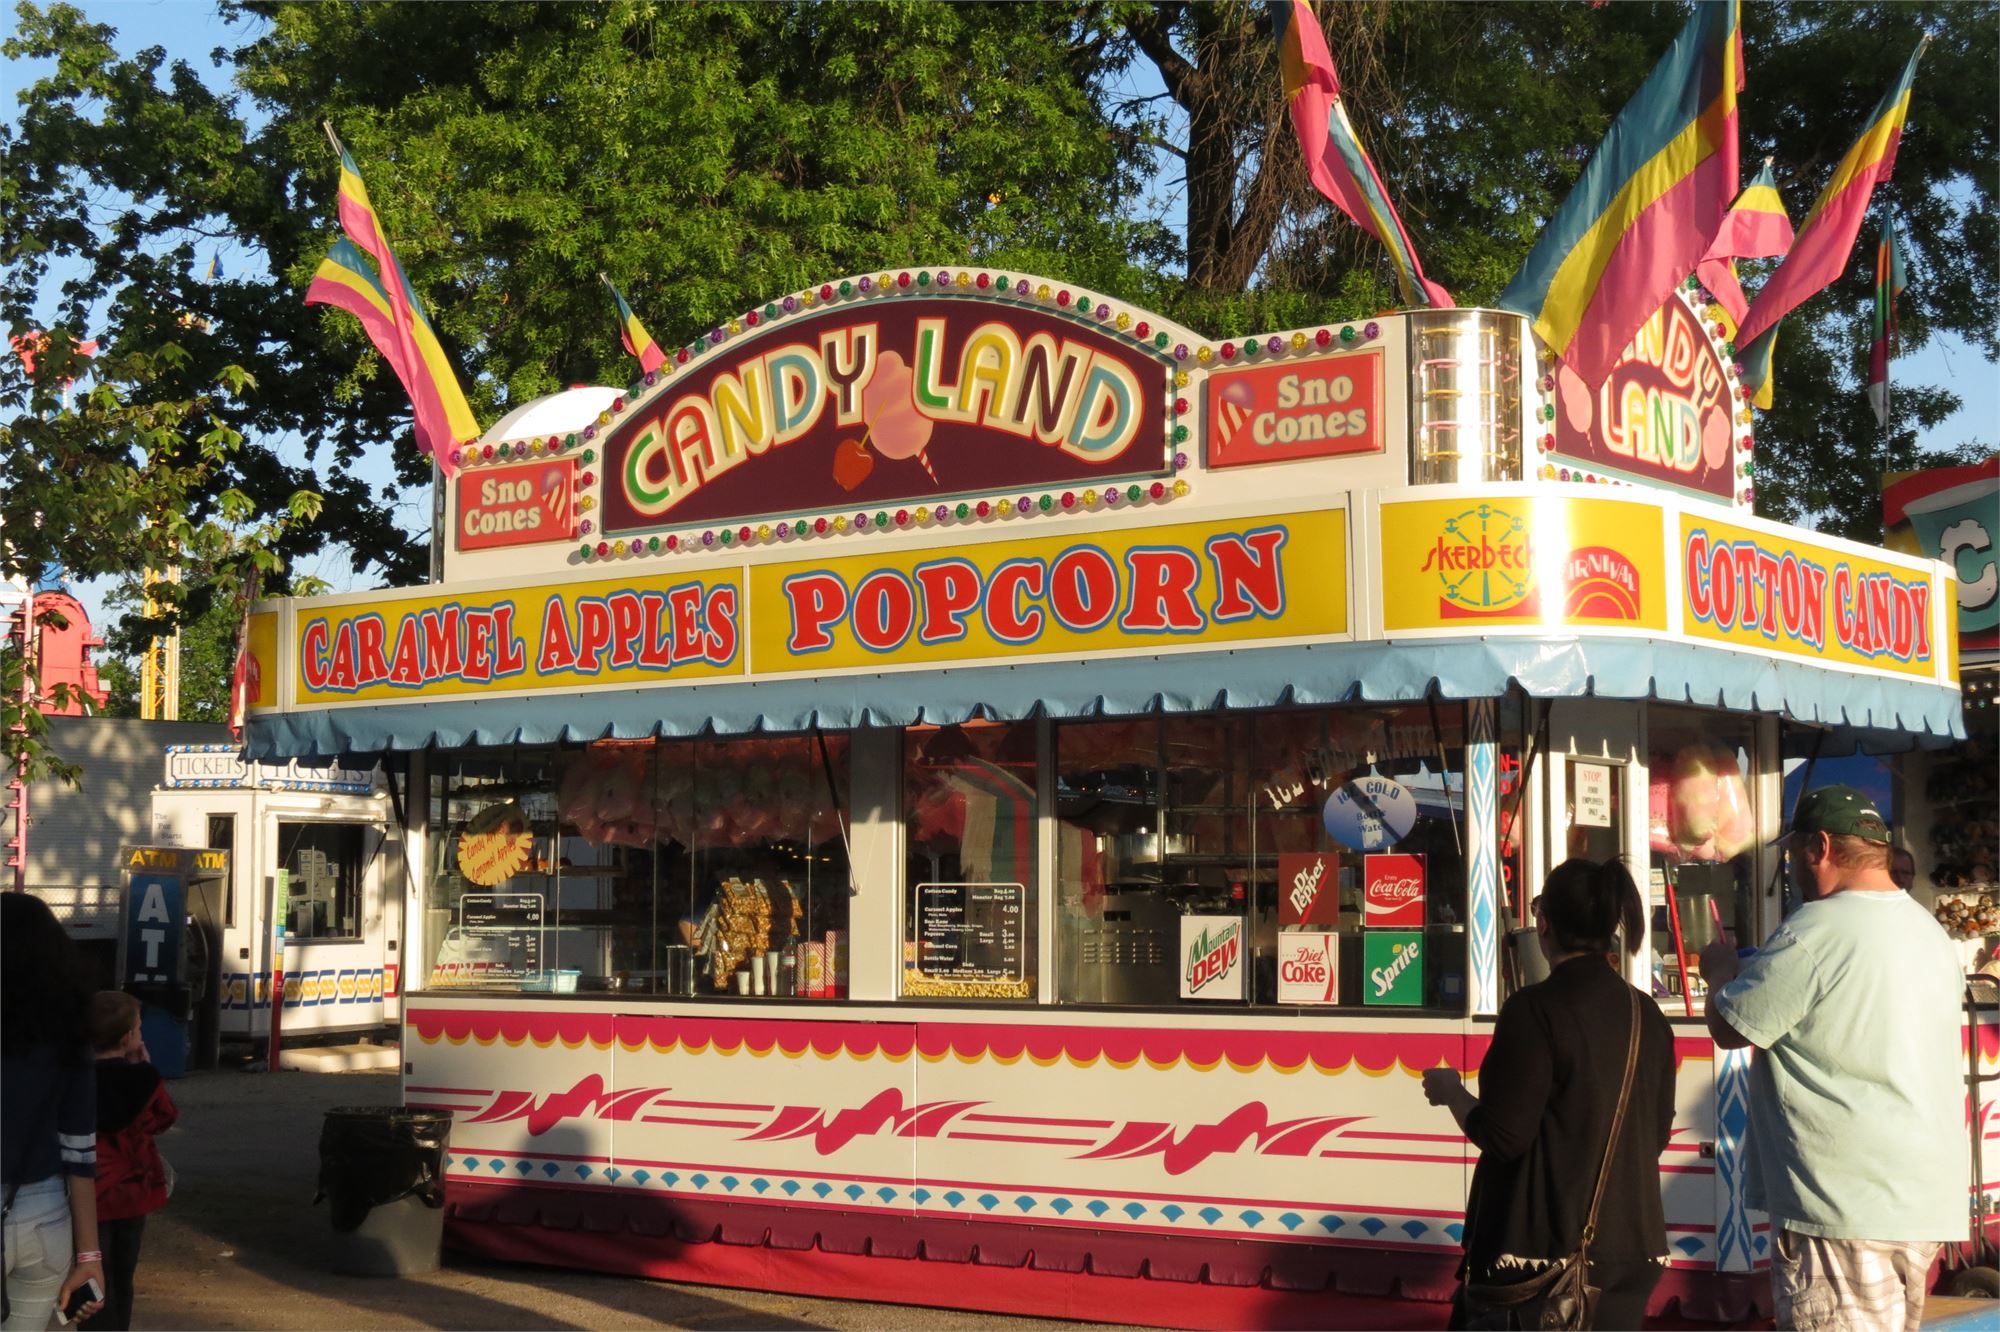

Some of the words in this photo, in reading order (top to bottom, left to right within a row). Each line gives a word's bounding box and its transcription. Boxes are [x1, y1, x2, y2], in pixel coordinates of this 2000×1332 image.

[1278, 374, 1353, 408] Sno
[621, 317, 878, 514] CANDY
[913, 317, 1145, 463] LAND
[1253, 408, 1368, 446] Cones
[1600, 374, 1701, 474] LAND
[481, 478, 532, 506] Sno
[464, 505, 541, 536] Cones
[783, 524, 1289, 656] POPCORN
[1686, 528, 1828, 652] COTTON
[1833, 562, 1930, 662] CANDY
[302, 599, 526, 693] CARAMEL
[538, 580, 740, 676] APPLES
[177, 757, 243, 775] TICKETS
[129, 850, 176, 867] ATM
[193, 852, 225, 868] ATM
[1289, 857, 1324, 916] Pepper
[1294, 867, 1310, 893] Dr
[1369, 879, 1421, 897] Coca-Cola
[1002, 904, 1019, 914] 4.00
[134, 884, 170, 982] AT
[1187, 921, 1238, 981] Mountain
[1295, 946, 1324, 963] Diet
[1281, 960, 1326, 983] Coke
[1371, 942, 1420, 997] Sprite
